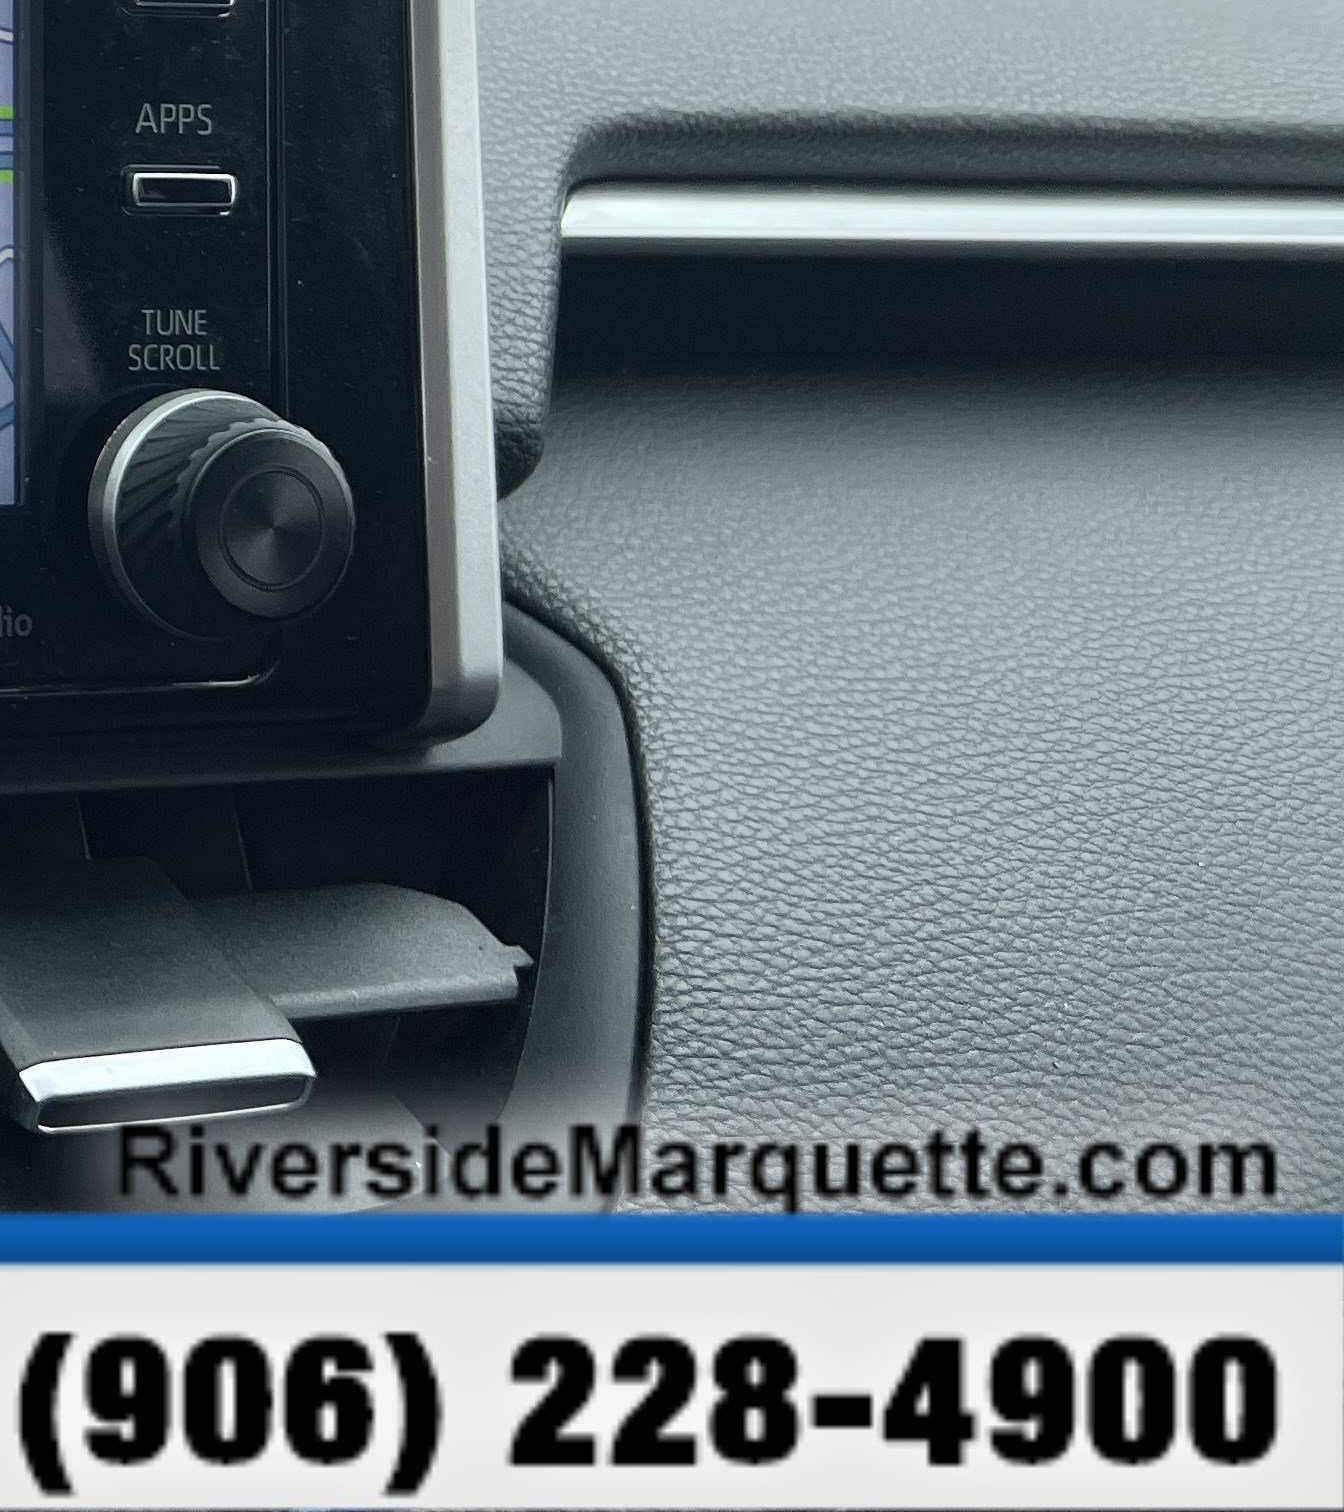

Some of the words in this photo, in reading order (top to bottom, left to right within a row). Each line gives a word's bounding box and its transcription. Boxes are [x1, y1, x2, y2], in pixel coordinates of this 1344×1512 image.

[134, 102, 213, 136] APPS
[141, 308, 208, 337] TUNE
[127, 343, 221, 372] SCROLL
